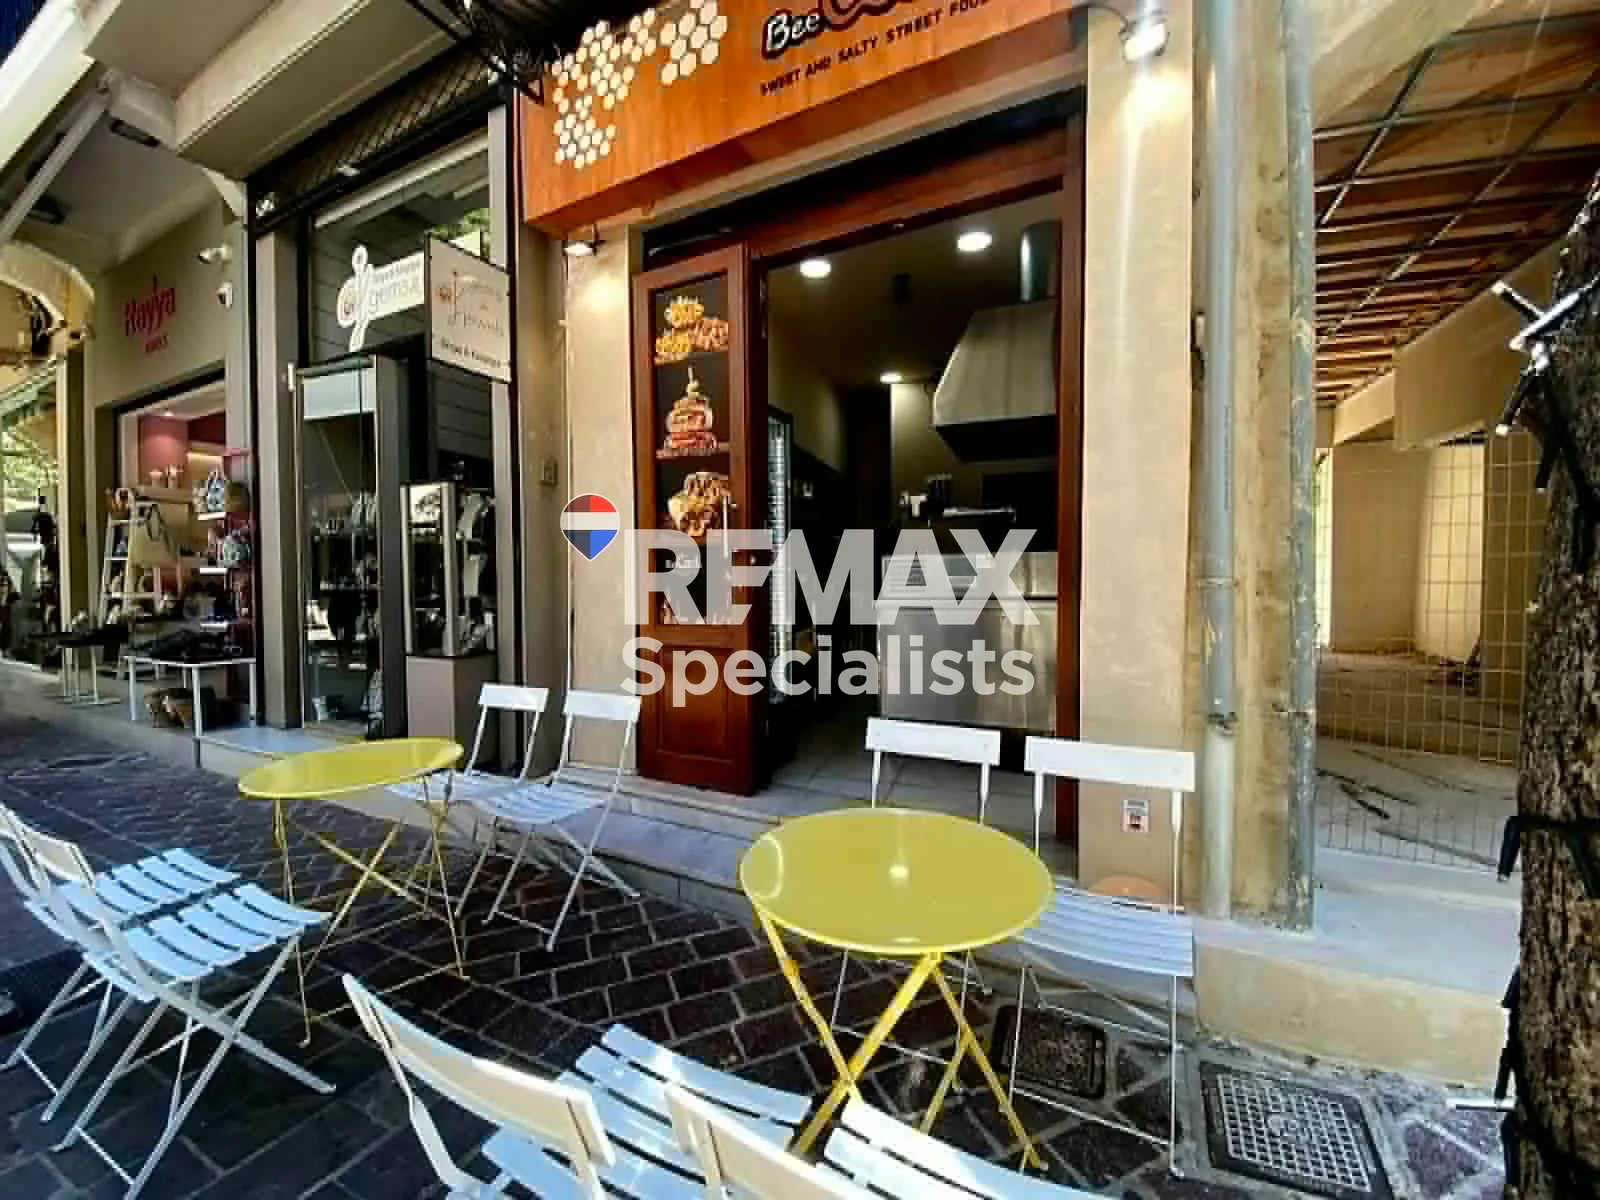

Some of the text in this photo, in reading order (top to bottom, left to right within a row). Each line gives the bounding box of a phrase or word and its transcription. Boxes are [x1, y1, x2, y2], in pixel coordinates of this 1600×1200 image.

[761, 68, 801, 96] SWEET
[805, 55, 831, 78] AND
[838, 35, 878, 62] SALTY
[886, 8, 943, 43] STREET
[763, 11, 822, 56] Bee
